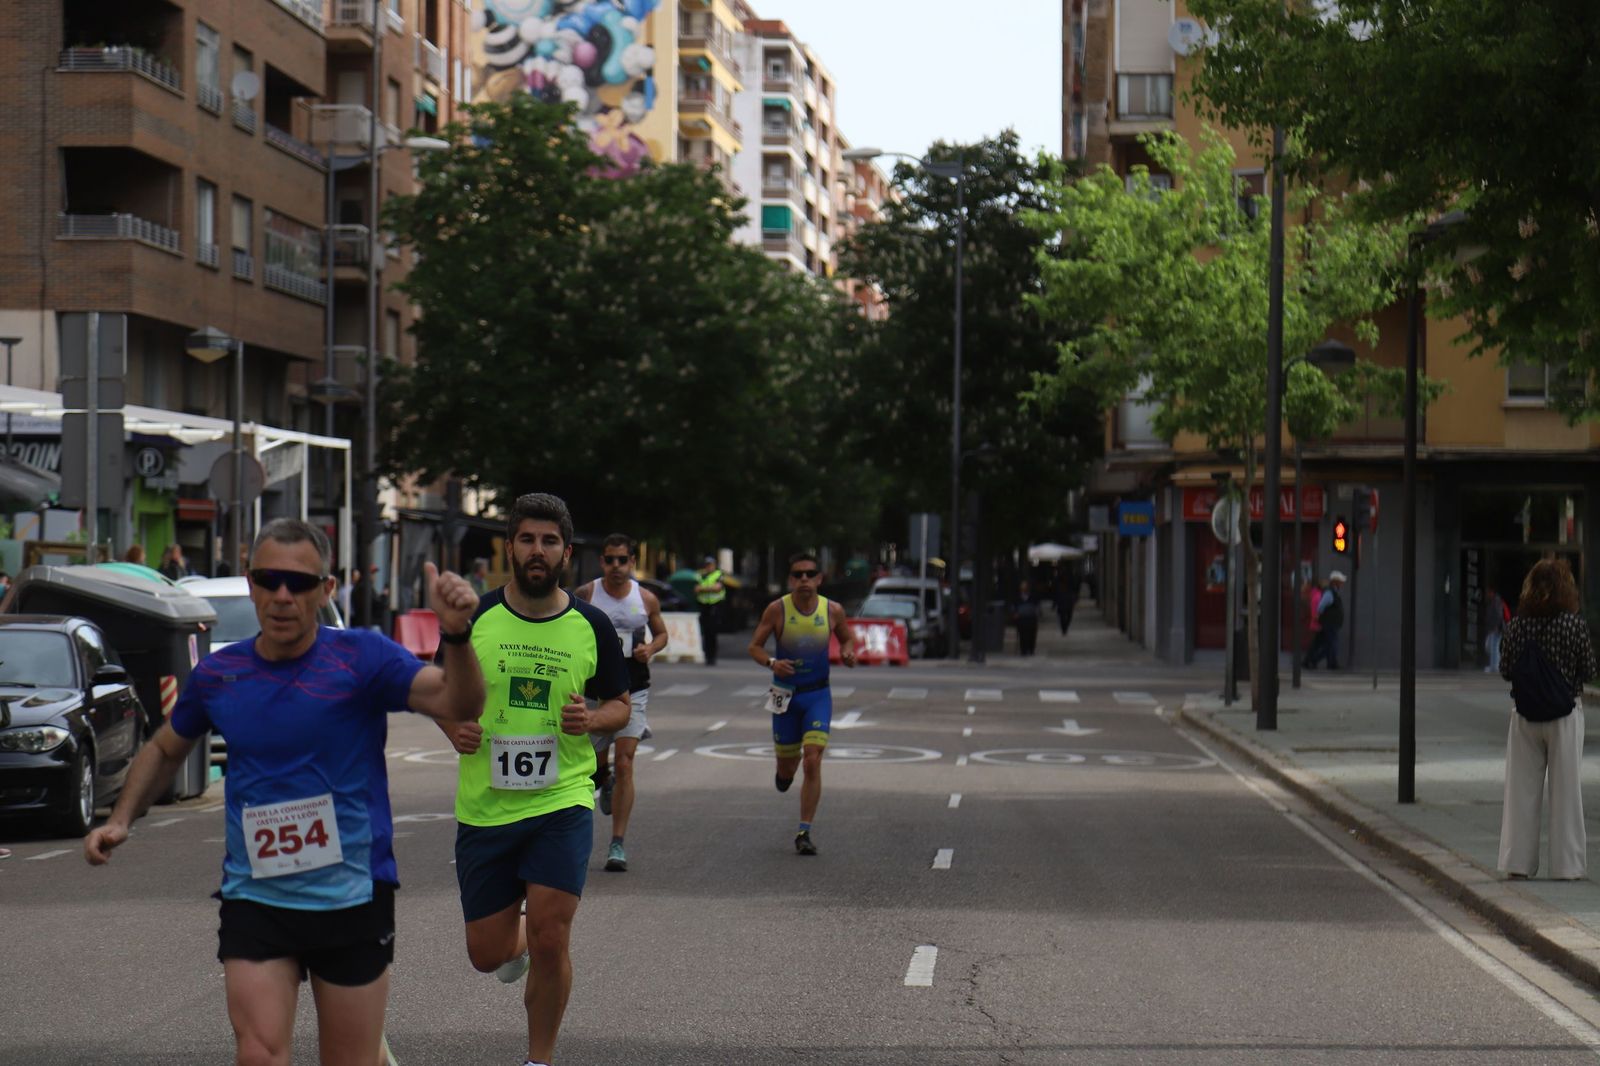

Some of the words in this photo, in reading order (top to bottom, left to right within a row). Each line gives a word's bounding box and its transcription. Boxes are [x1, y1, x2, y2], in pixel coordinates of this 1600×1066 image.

[522, 644, 542, 652] Media
[544, 647, 572, 659] Maratón
[527, 701, 548, 709] RURAL
[541, 737, 554, 745] LEÓN
[498, 751, 551, 777] 167
[257, 810, 267, 818] DE
[269, 808, 279, 816] LA
[280, 799, 329, 814] COMUNIDAD
[256, 815, 290, 826] CASTILLA
[297, 809, 319, 819] LEÓN
[254, 818, 329, 859] 254
